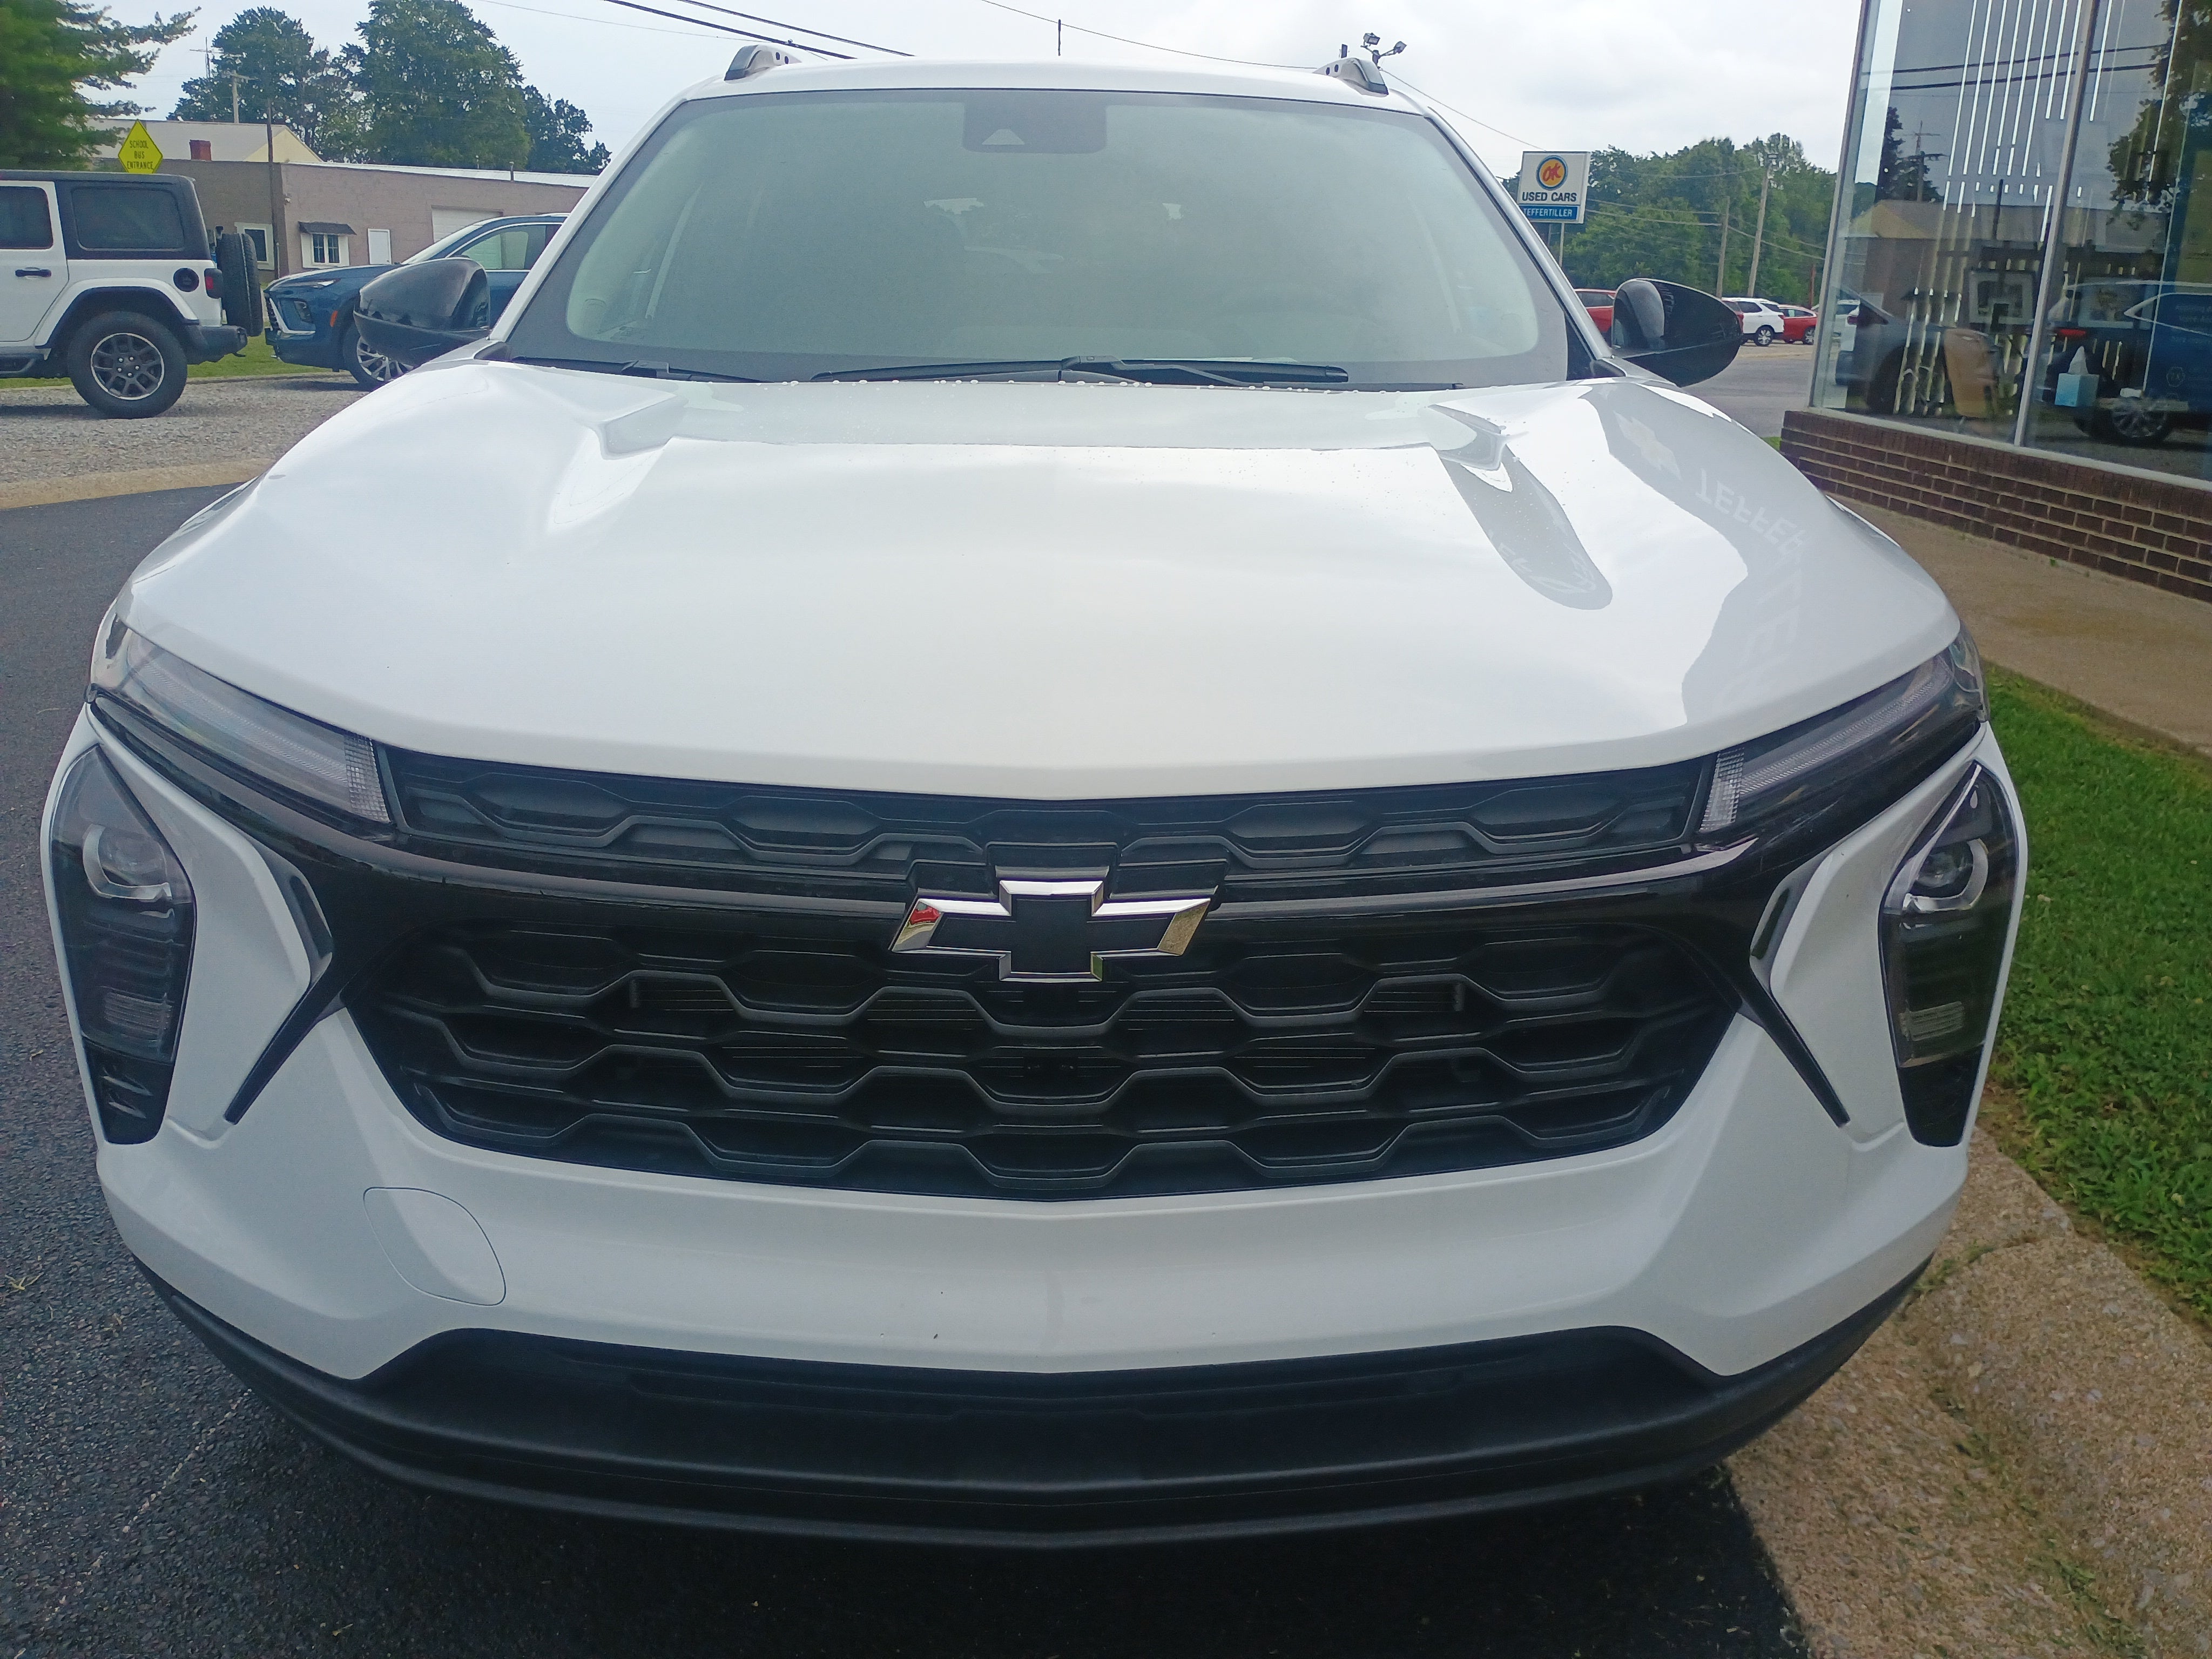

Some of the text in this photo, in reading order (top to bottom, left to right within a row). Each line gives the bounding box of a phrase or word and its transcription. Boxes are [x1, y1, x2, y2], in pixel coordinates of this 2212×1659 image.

[130, 140, 149, 149] SCHOOL
[134, 151, 145, 159] BUS
[127, 161, 153, 170] ENTRANCE
[1542, 163, 1561, 182] OK
[1522, 192, 1577, 201] USED CARS
